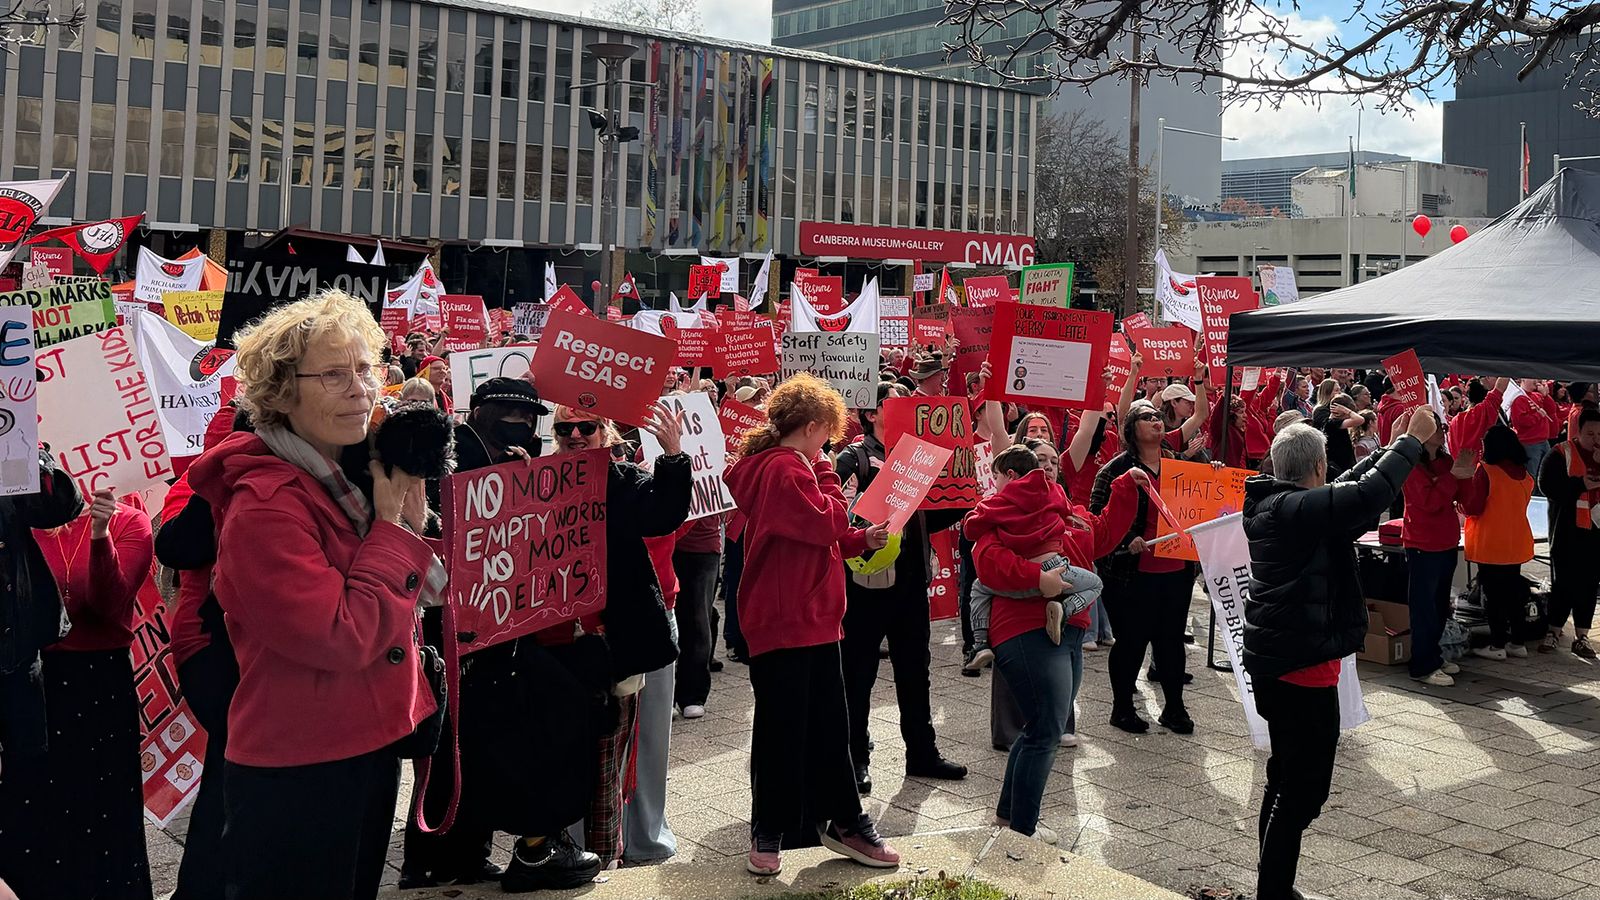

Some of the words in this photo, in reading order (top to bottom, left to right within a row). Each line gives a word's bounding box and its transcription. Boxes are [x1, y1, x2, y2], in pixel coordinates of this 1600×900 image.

[813, 234, 860, 246] CANBERRA
[861, 237, 944, 251] MUSEUM+GALLERY
[965, 240, 1035, 266] CMAG
[0, 290, 42, 308] OOD
[50, 281, 112, 306] MARKS
[333, 273, 379, 303] NO
[1026, 279, 1060, 295] FIGHT
[1200, 284, 1240, 303] Resource
[32, 304, 72, 329] NOT
[173, 304, 205, 325] Retain
[205, 302, 221, 322] tea
[1015, 307, 1035, 319] YOUR
[1204, 303, 1223, 314] the
[820, 316, 849, 328] AEU
[1014, 319, 1046, 336] BERRY
[1058, 324, 1088, 340] LATE!
[1206, 316, 1229, 327] futu
[0, 320, 31, 366] E
[782, 334, 821, 350] Staff
[826, 333, 868, 351] Safety
[1142, 338, 1188, 349] Respect
[1208, 331, 1227, 340] our
[95, 327, 137, 373] KIDS
[554, 330, 656, 375] Respect
[715, 345, 728, 353] the
[728, 343, 753, 352] future
[724, 349, 760, 360] students
[960, 344, 990, 355] OVERW
[1153, 350, 1181, 361] LSAs
[1210, 344, 1227, 354] stu
[35, 348, 66, 382] ST
[727, 357, 760, 367] deserve
[783, 351, 795, 362] is
[799, 353, 816, 368] my
[821, 351, 865, 364] favourite
[1212, 356, 1227, 367] de
[564, 356, 628, 390] LSAs
[1405, 375, 1420, 387] our
[115, 371, 157, 425] THE
[160, 393, 214, 409] HAWKER
[722, 407, 739, 420] We
[915, 402, 966, 438] FOR
[134, 419, 172, 479] FOR
[186, 434, 205, 449] SU
[59, 428, 132, 477] LIST
[890, 459, 906, 475] the
[465, 472, 504, 522] NO
[512, 460, 588, 506] MORE
[891, 479, 920, 498] students
[1171, 472, 1225, 501] THAT'S
[1178, 507, 1205, 521] NOT
[466, 510, 551, 562] EMPTY
[551, 502, 606, 531] WORDS
[483, 550, 514, 586] NO
[528, 525, 591, 572] MORE
[1232, 563, 1251, 601] HIG
[493, 560, 589, 625] DELAYS
[1213, 574, 1255, 695] SUB-BRACH
